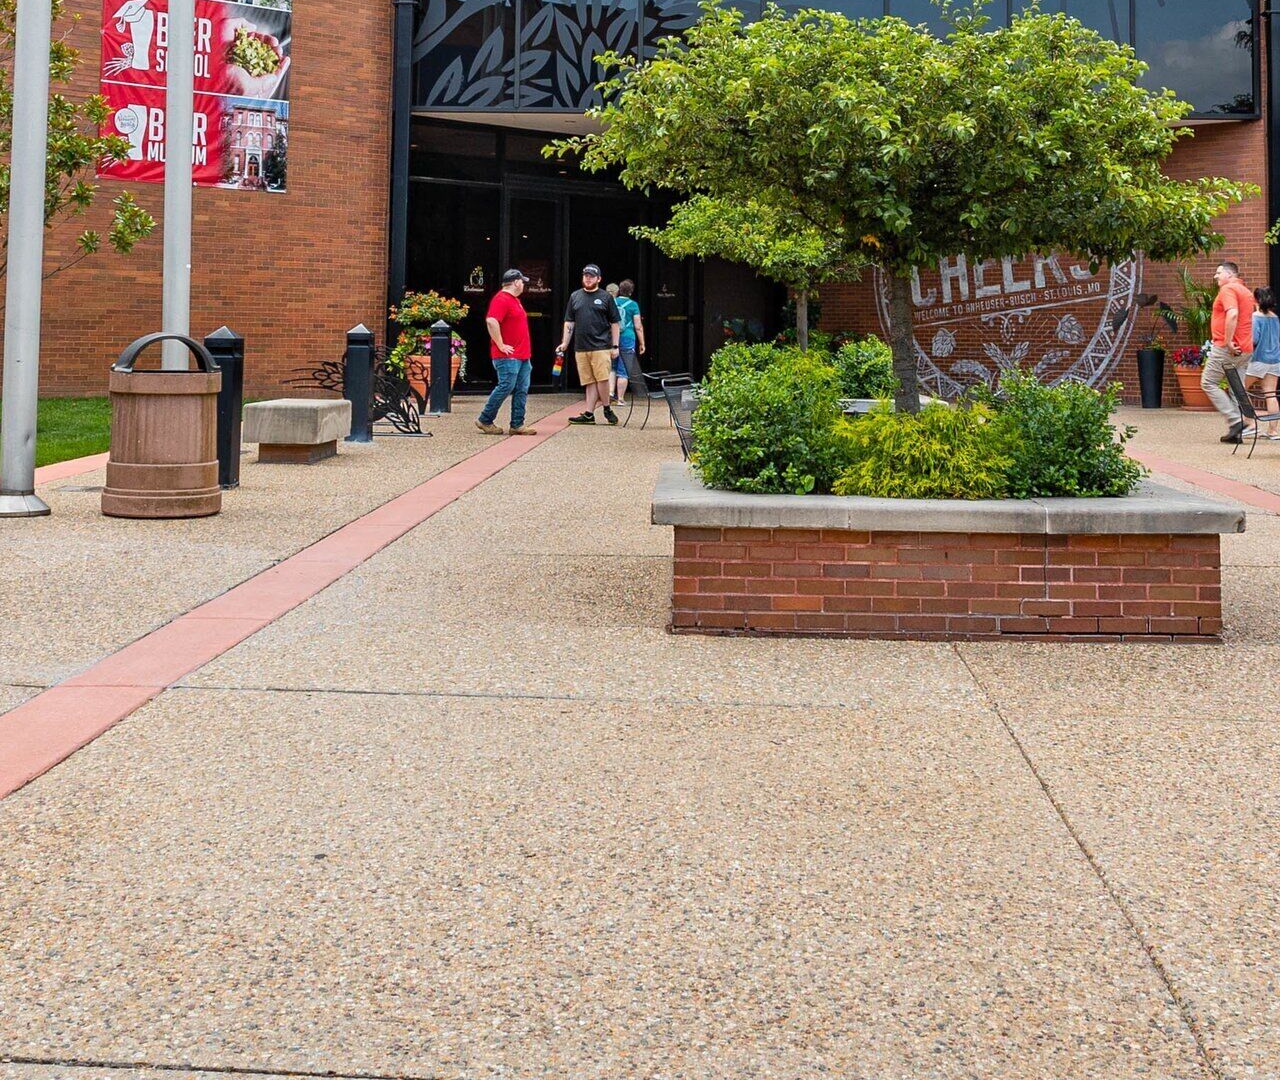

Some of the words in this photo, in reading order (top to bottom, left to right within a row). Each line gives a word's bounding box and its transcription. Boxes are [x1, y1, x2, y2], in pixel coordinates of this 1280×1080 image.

[157, 12, 212, 53] BR
[148, 107, 208, 146] BR
[913, 305, 949, 322] WELCOME
[953, 304, 963, 316] TO
